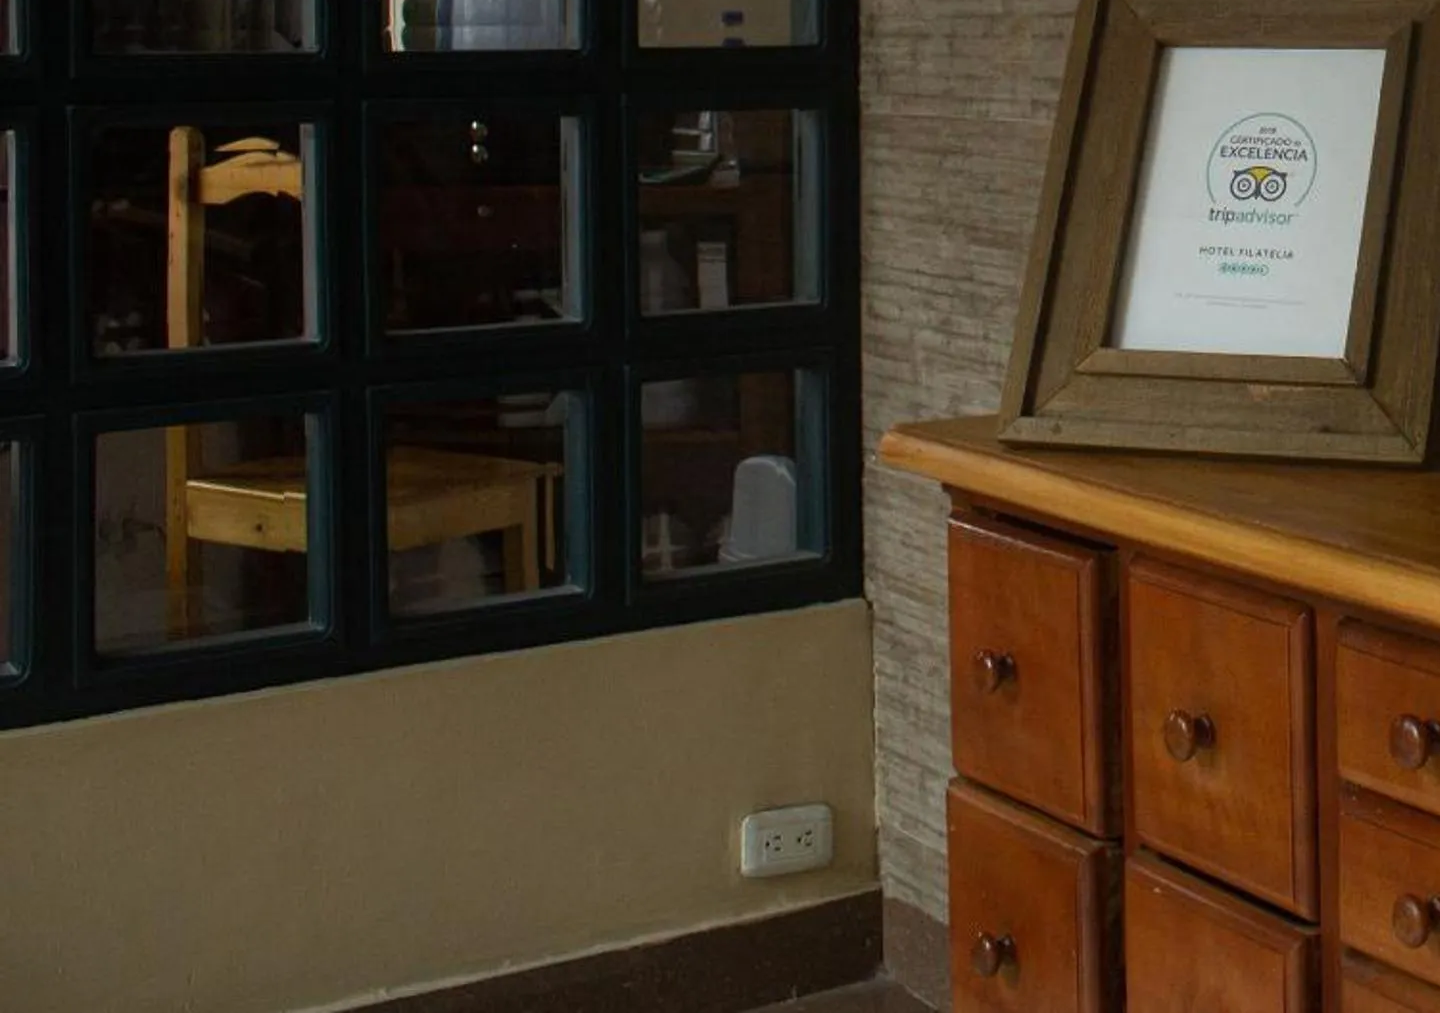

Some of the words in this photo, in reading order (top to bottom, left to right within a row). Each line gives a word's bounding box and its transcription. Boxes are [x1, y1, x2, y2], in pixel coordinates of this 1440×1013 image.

[1229, 134, 1292, 147] CERTIFICADO
[1219, 145, 1308, 162] EXCELENCIA
[1208, 207, 1294, 226] tripadvisor
[1199, 246, 1235, 257] HOTEL
